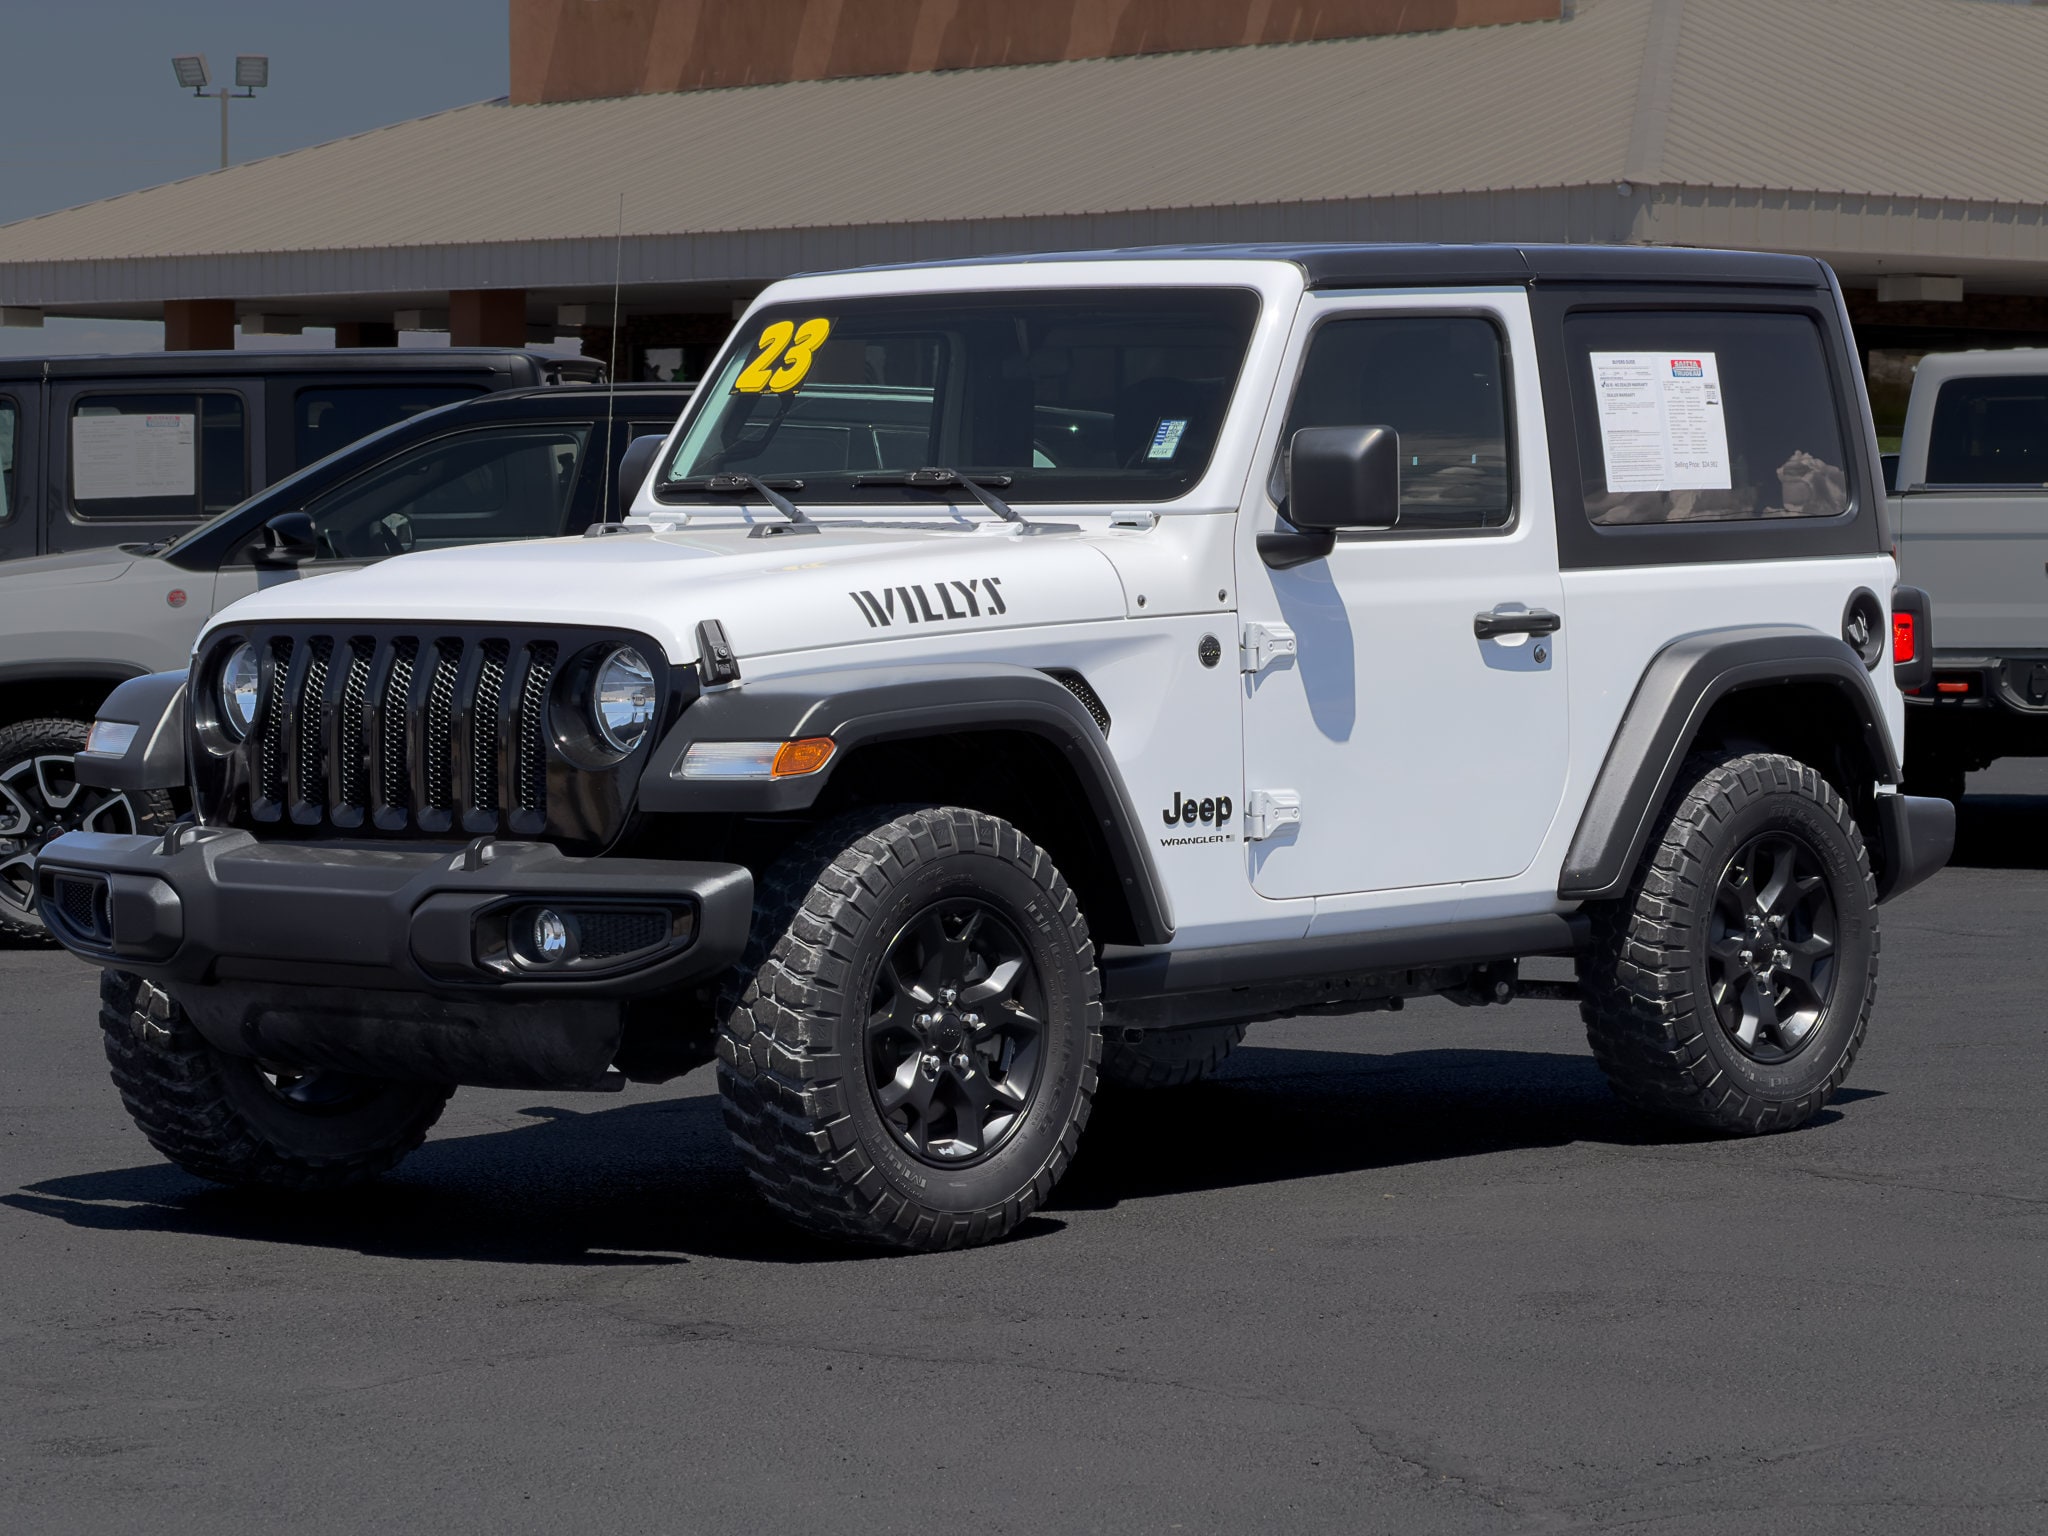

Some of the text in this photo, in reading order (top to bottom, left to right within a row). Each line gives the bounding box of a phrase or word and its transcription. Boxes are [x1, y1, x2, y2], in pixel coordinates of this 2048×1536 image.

[735, 318, 830, 393] 23
[1675, 461, 1688, 469] Selling
[849, 577, 1006, 628] WILLYS
[1163, 792, 1232, 828] Jeep
[1160, 835, 1224, 847] WRANGLER
